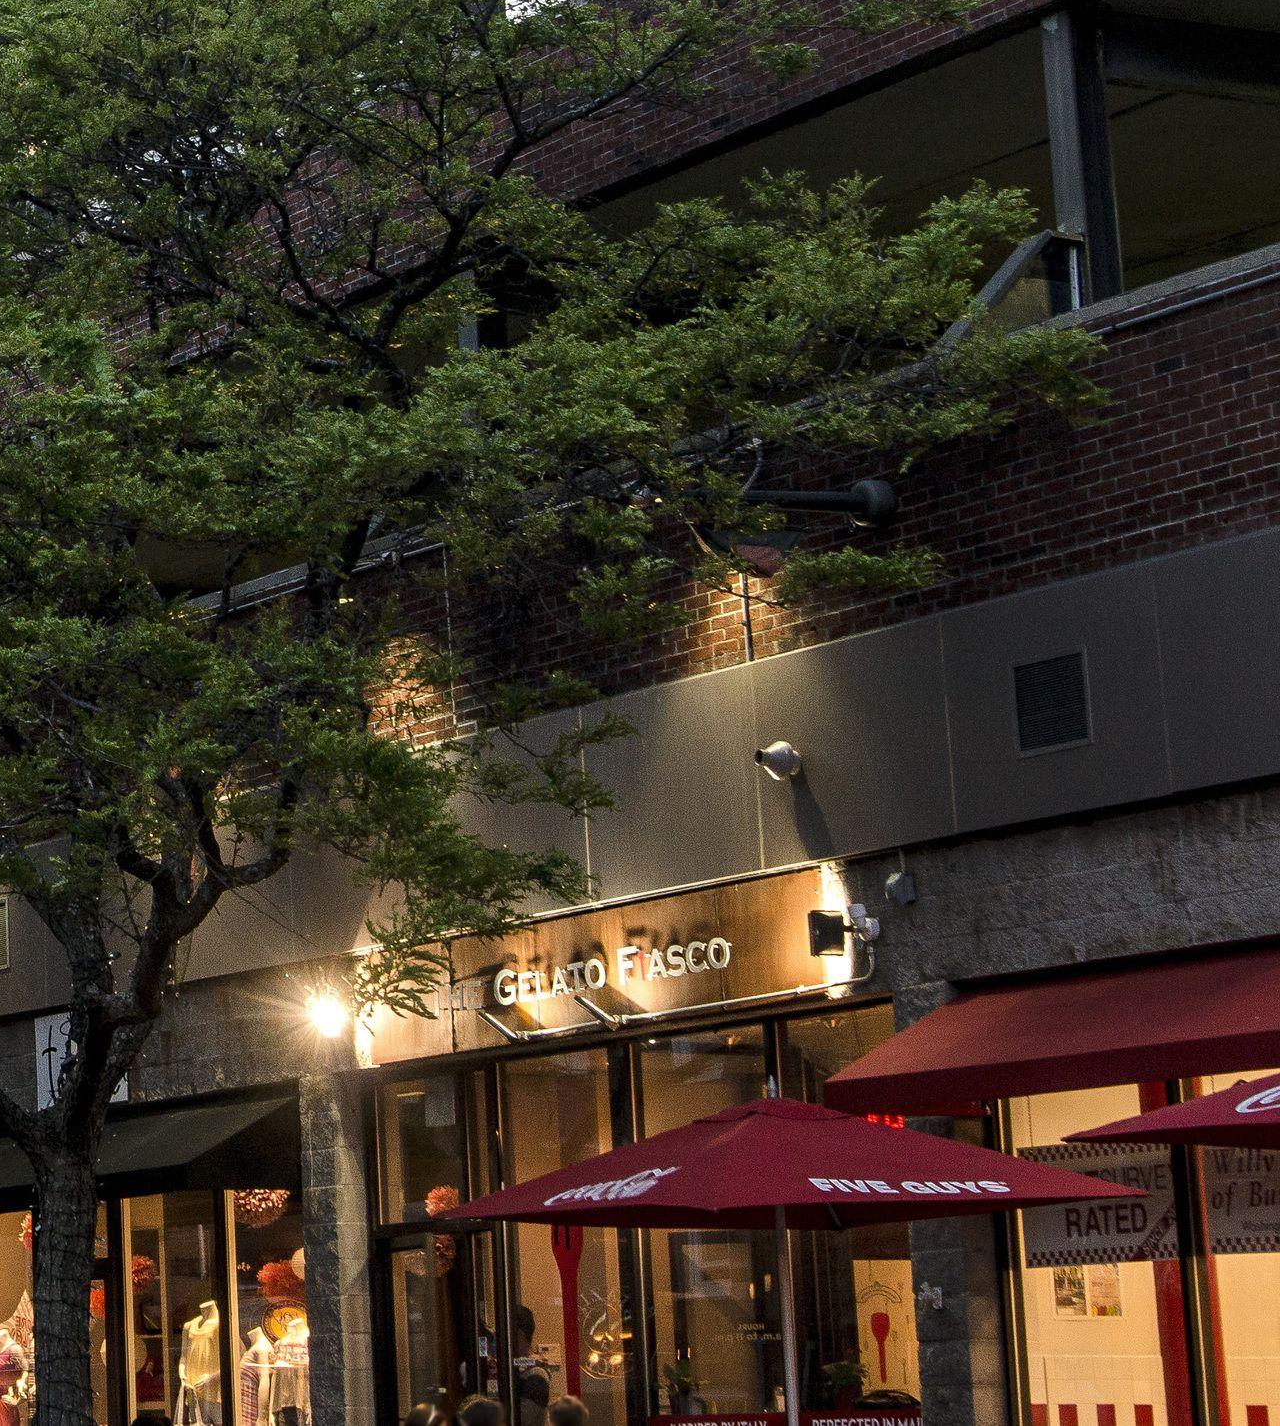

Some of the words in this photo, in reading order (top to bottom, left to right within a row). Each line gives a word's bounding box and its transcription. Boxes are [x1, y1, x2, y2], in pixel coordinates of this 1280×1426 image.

[493, 958, 606, 1006] GELATO
[616, 937, 732, 986] FIASCO
[808, 1177, 900, 1194] FIVE
[900, 1180, 1011, 1194] GUYS
[1212, 1182, 1237, 1217] of
[1249, 1180, 1280, 1208] Bu
[1064, 1203, 1148, 1239] RATED
